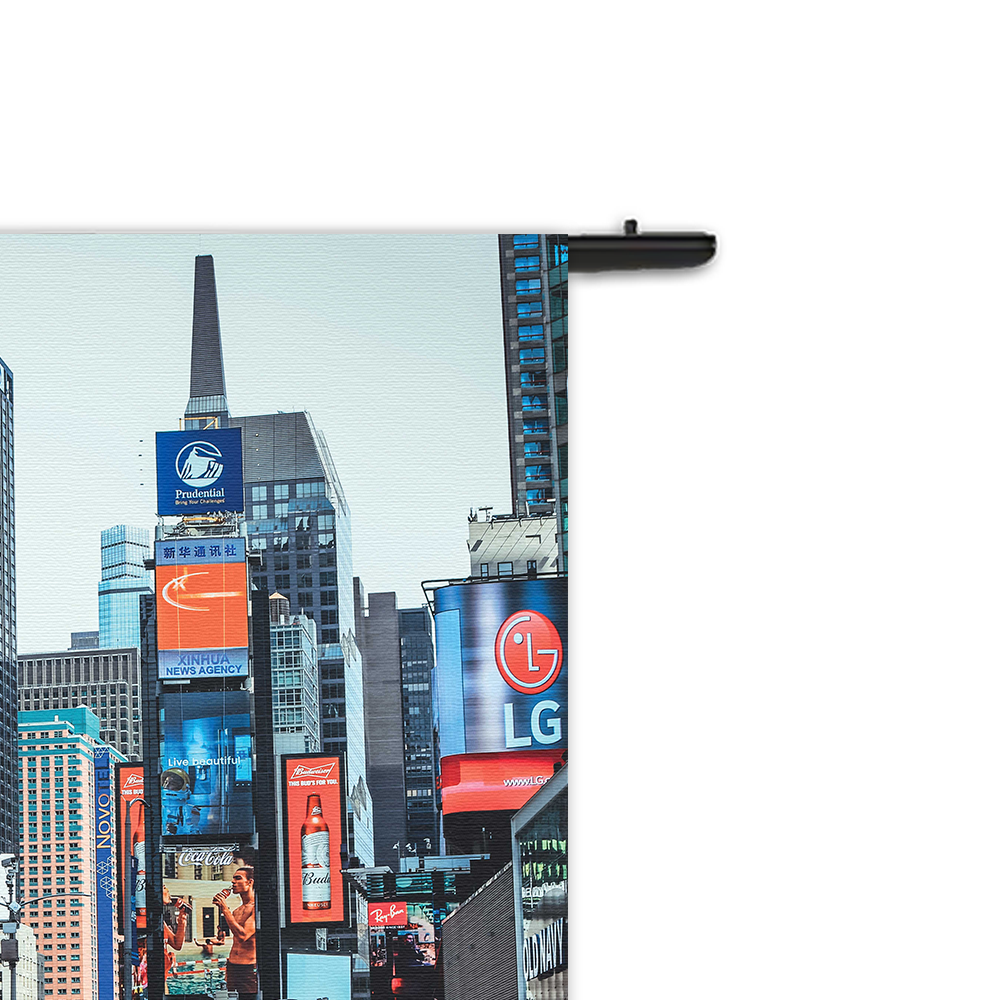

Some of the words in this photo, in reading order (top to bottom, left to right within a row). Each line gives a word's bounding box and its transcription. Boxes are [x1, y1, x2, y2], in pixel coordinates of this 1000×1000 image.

[175, 487, 225, 499] Prudential
[163, 544, 237, 559] 新华通讯社
[178, 653, 230, 666] XINHUA
[166, 666, 197, 676] NEWS
[200, 664, 242, 675] AGENCY
[504, 700, 562, 749] LG
[168, 757, 189, 767] Live
[192, 756, 241, 766] beautiful
[370, 904, 404, 923] Ray-Ban
[523, 933, 539, 981] OLD
[540, 917, 563, 975] NAVY
